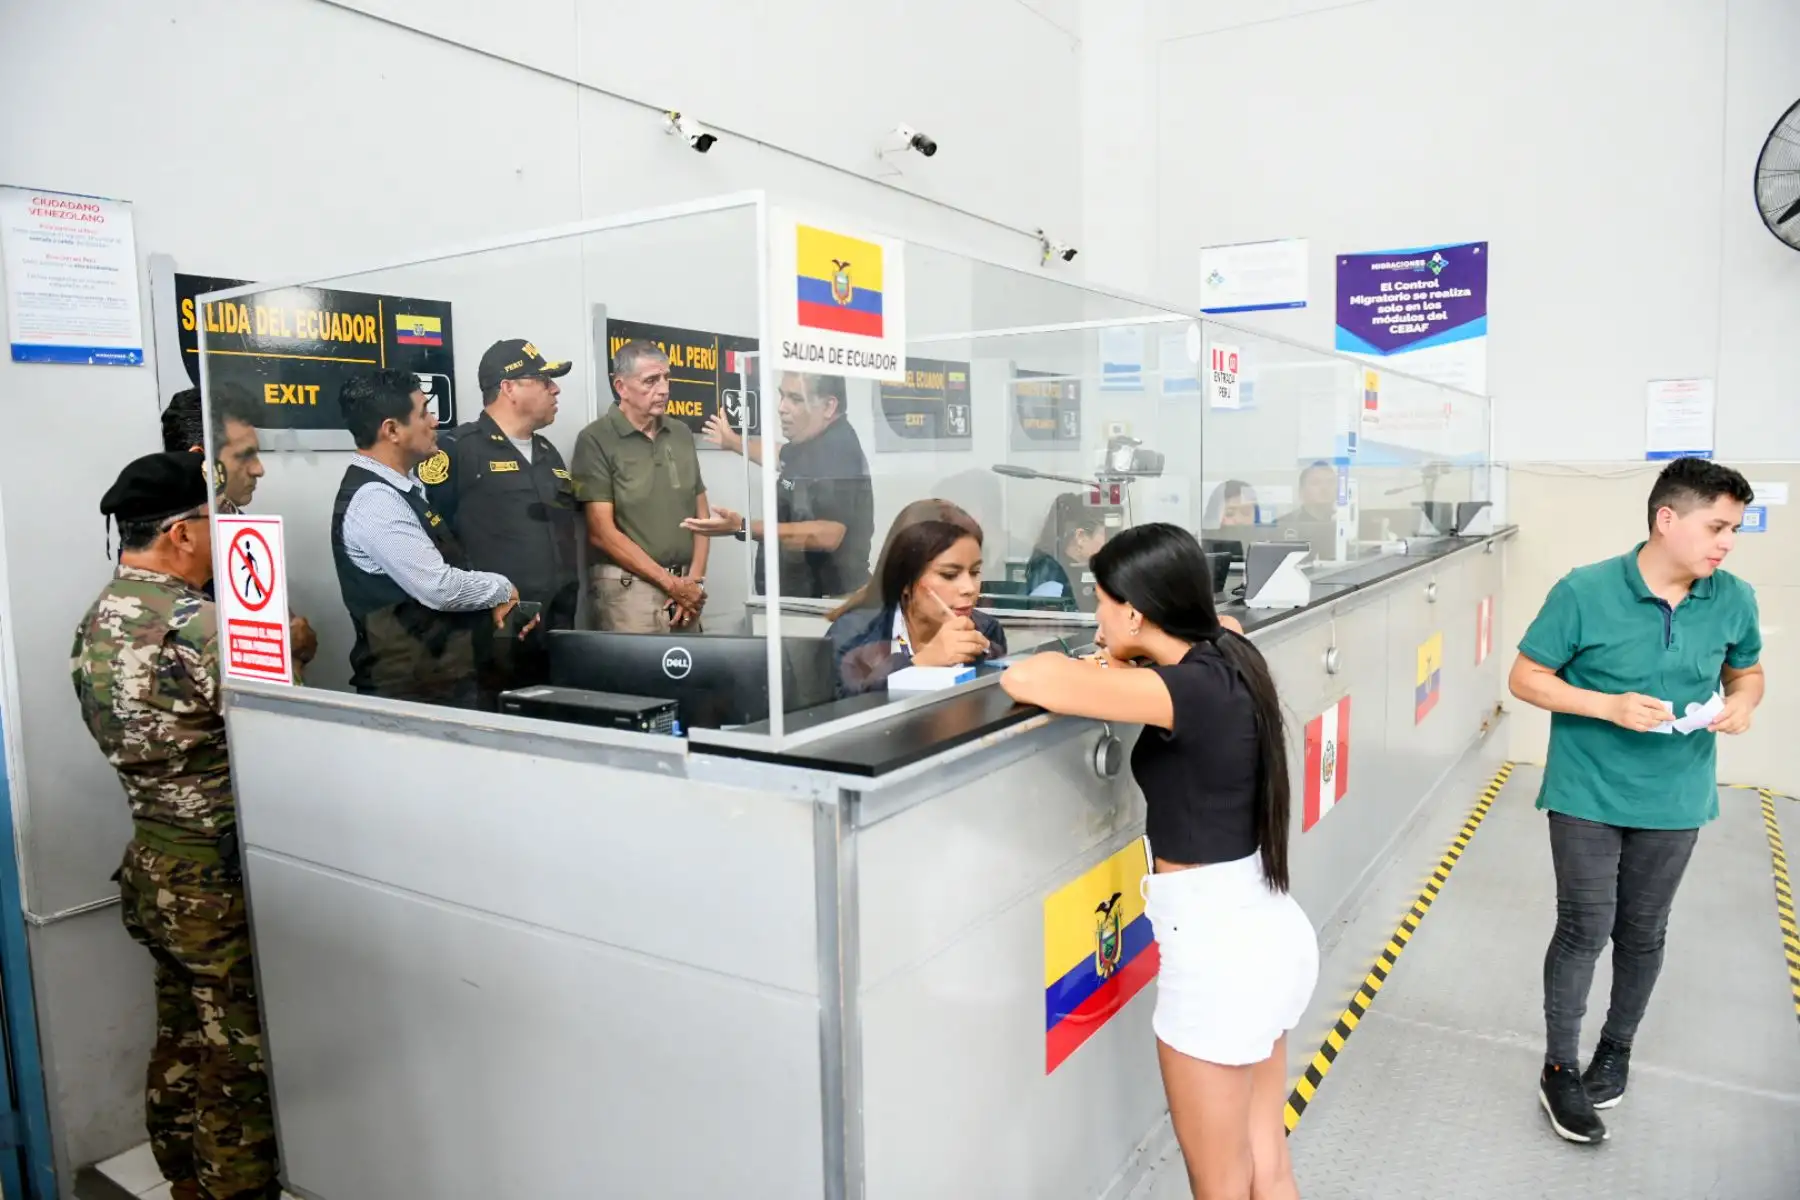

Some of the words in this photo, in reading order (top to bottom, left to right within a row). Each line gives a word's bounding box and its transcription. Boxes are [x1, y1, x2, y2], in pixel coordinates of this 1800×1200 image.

[32, 197, 100, 213] CIUDADANO
[28, 208, 105, 223] VENEZOLANO
[1371, 259, 1425, 271] MIGRACIONES
[1380, 282, 1393, 292] El
[1394, 279, 1440, 291] Control
[1350, 293, 1411, 306] Migratorio
[1413, 292, 1428, 301] se
[1429, 287, 1472, 299] realiza
[1377, 304, 1403, 314] solo
[1405, 304, 1421, 313] en
[1423, 301, 1442, 312] los
[256, 304, 293, 337] DEL
[296, 309, 377, 344] ECUADOR
[1372, 312, 1425, 325] módulos
[1427, 311, 1448, 322] del
[1389, 323, 1429, 334] CEBAF
[669, 343, 684, 367] AL
[686, 344, 717, 371] PERÚ
[783, 341, 825, 363] SALIDA
[829, 347, 843, 365] DE
[847, 350, 898, 371] ECUADOR
[264, 382, 320, 405] EXIT
[663, 400, 703, 417] ANCE
[666, 657, 689, 669] DELL
